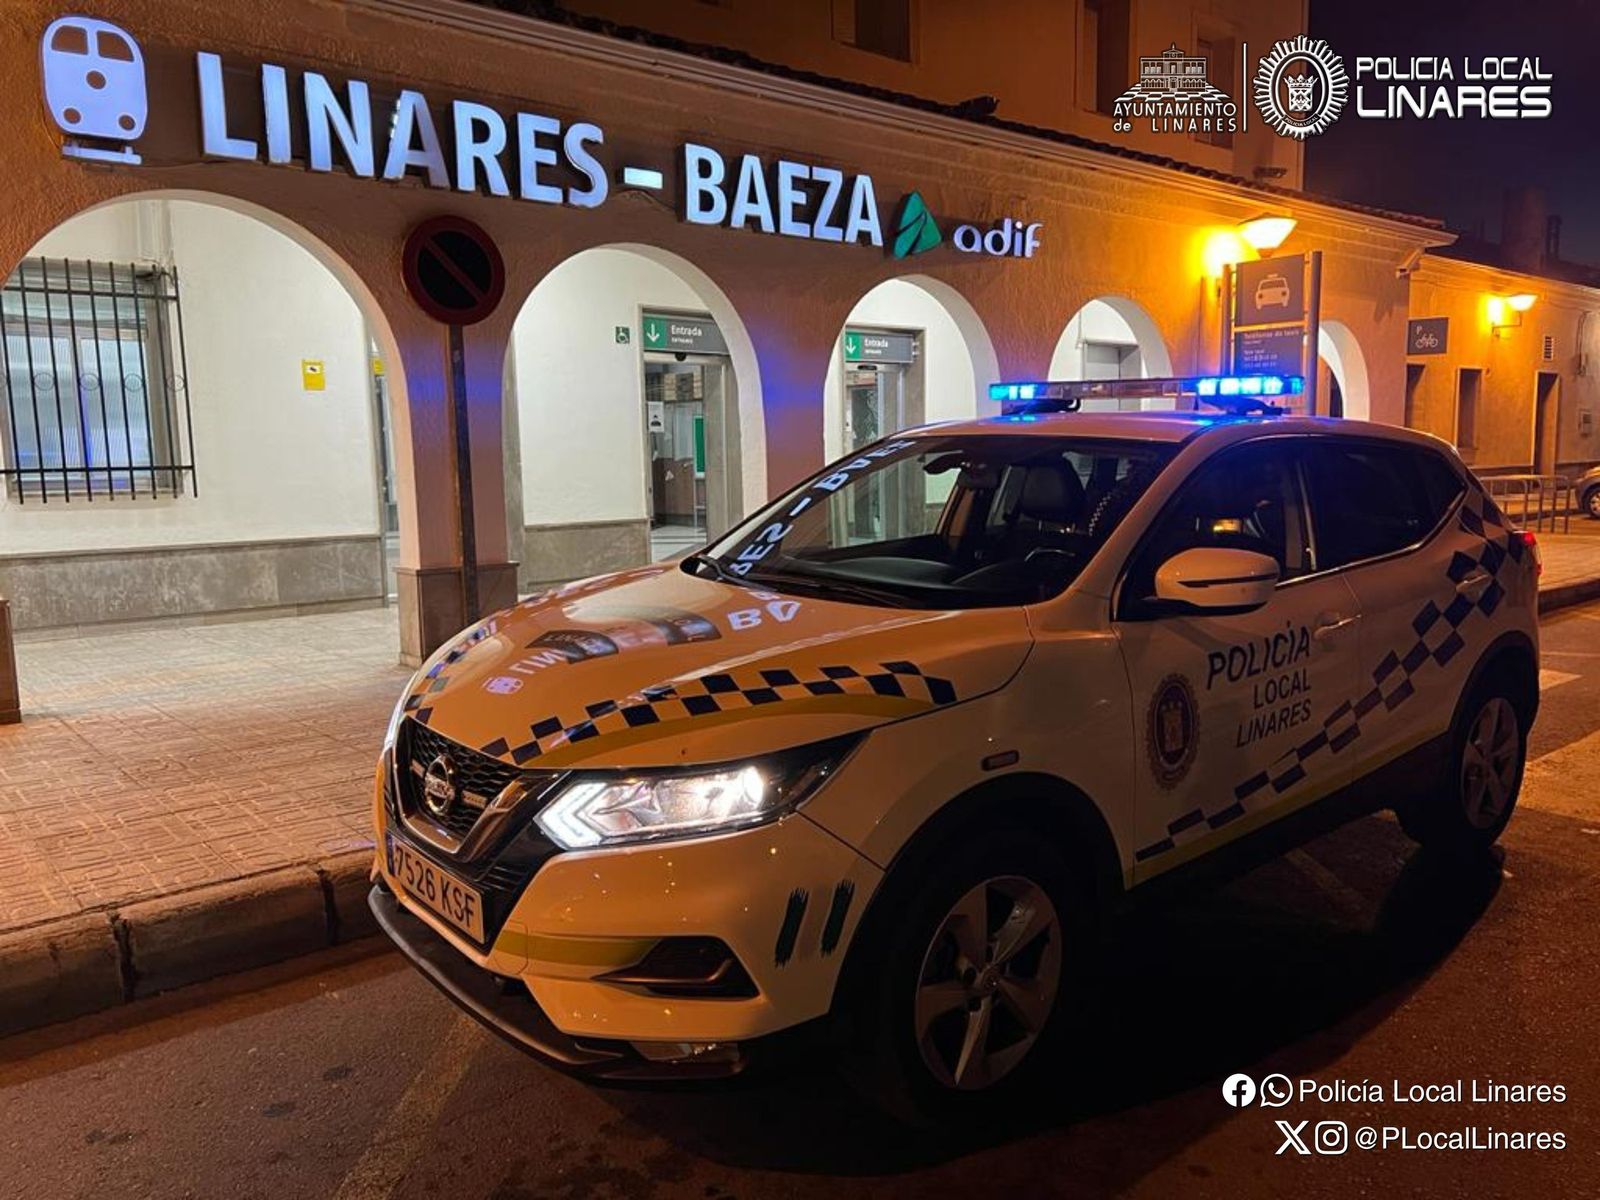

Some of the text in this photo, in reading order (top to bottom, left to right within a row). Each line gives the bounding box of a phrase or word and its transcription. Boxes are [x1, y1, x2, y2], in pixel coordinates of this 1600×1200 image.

[196, 51, 609, 209] LINARES
[684, 142, 884, 248] BAEZA
[952, 216, 1045, 258] adif
[671, 324, 702, 337] Entrada
[864, 337, 889, 348] Entrada
[1253, 668, 1312, 710] LOCAL
[1236, 699, 1312, 748] LINARES
[395, 844, 436, 902] 7526
[440, 875, 475, 928] KSF
